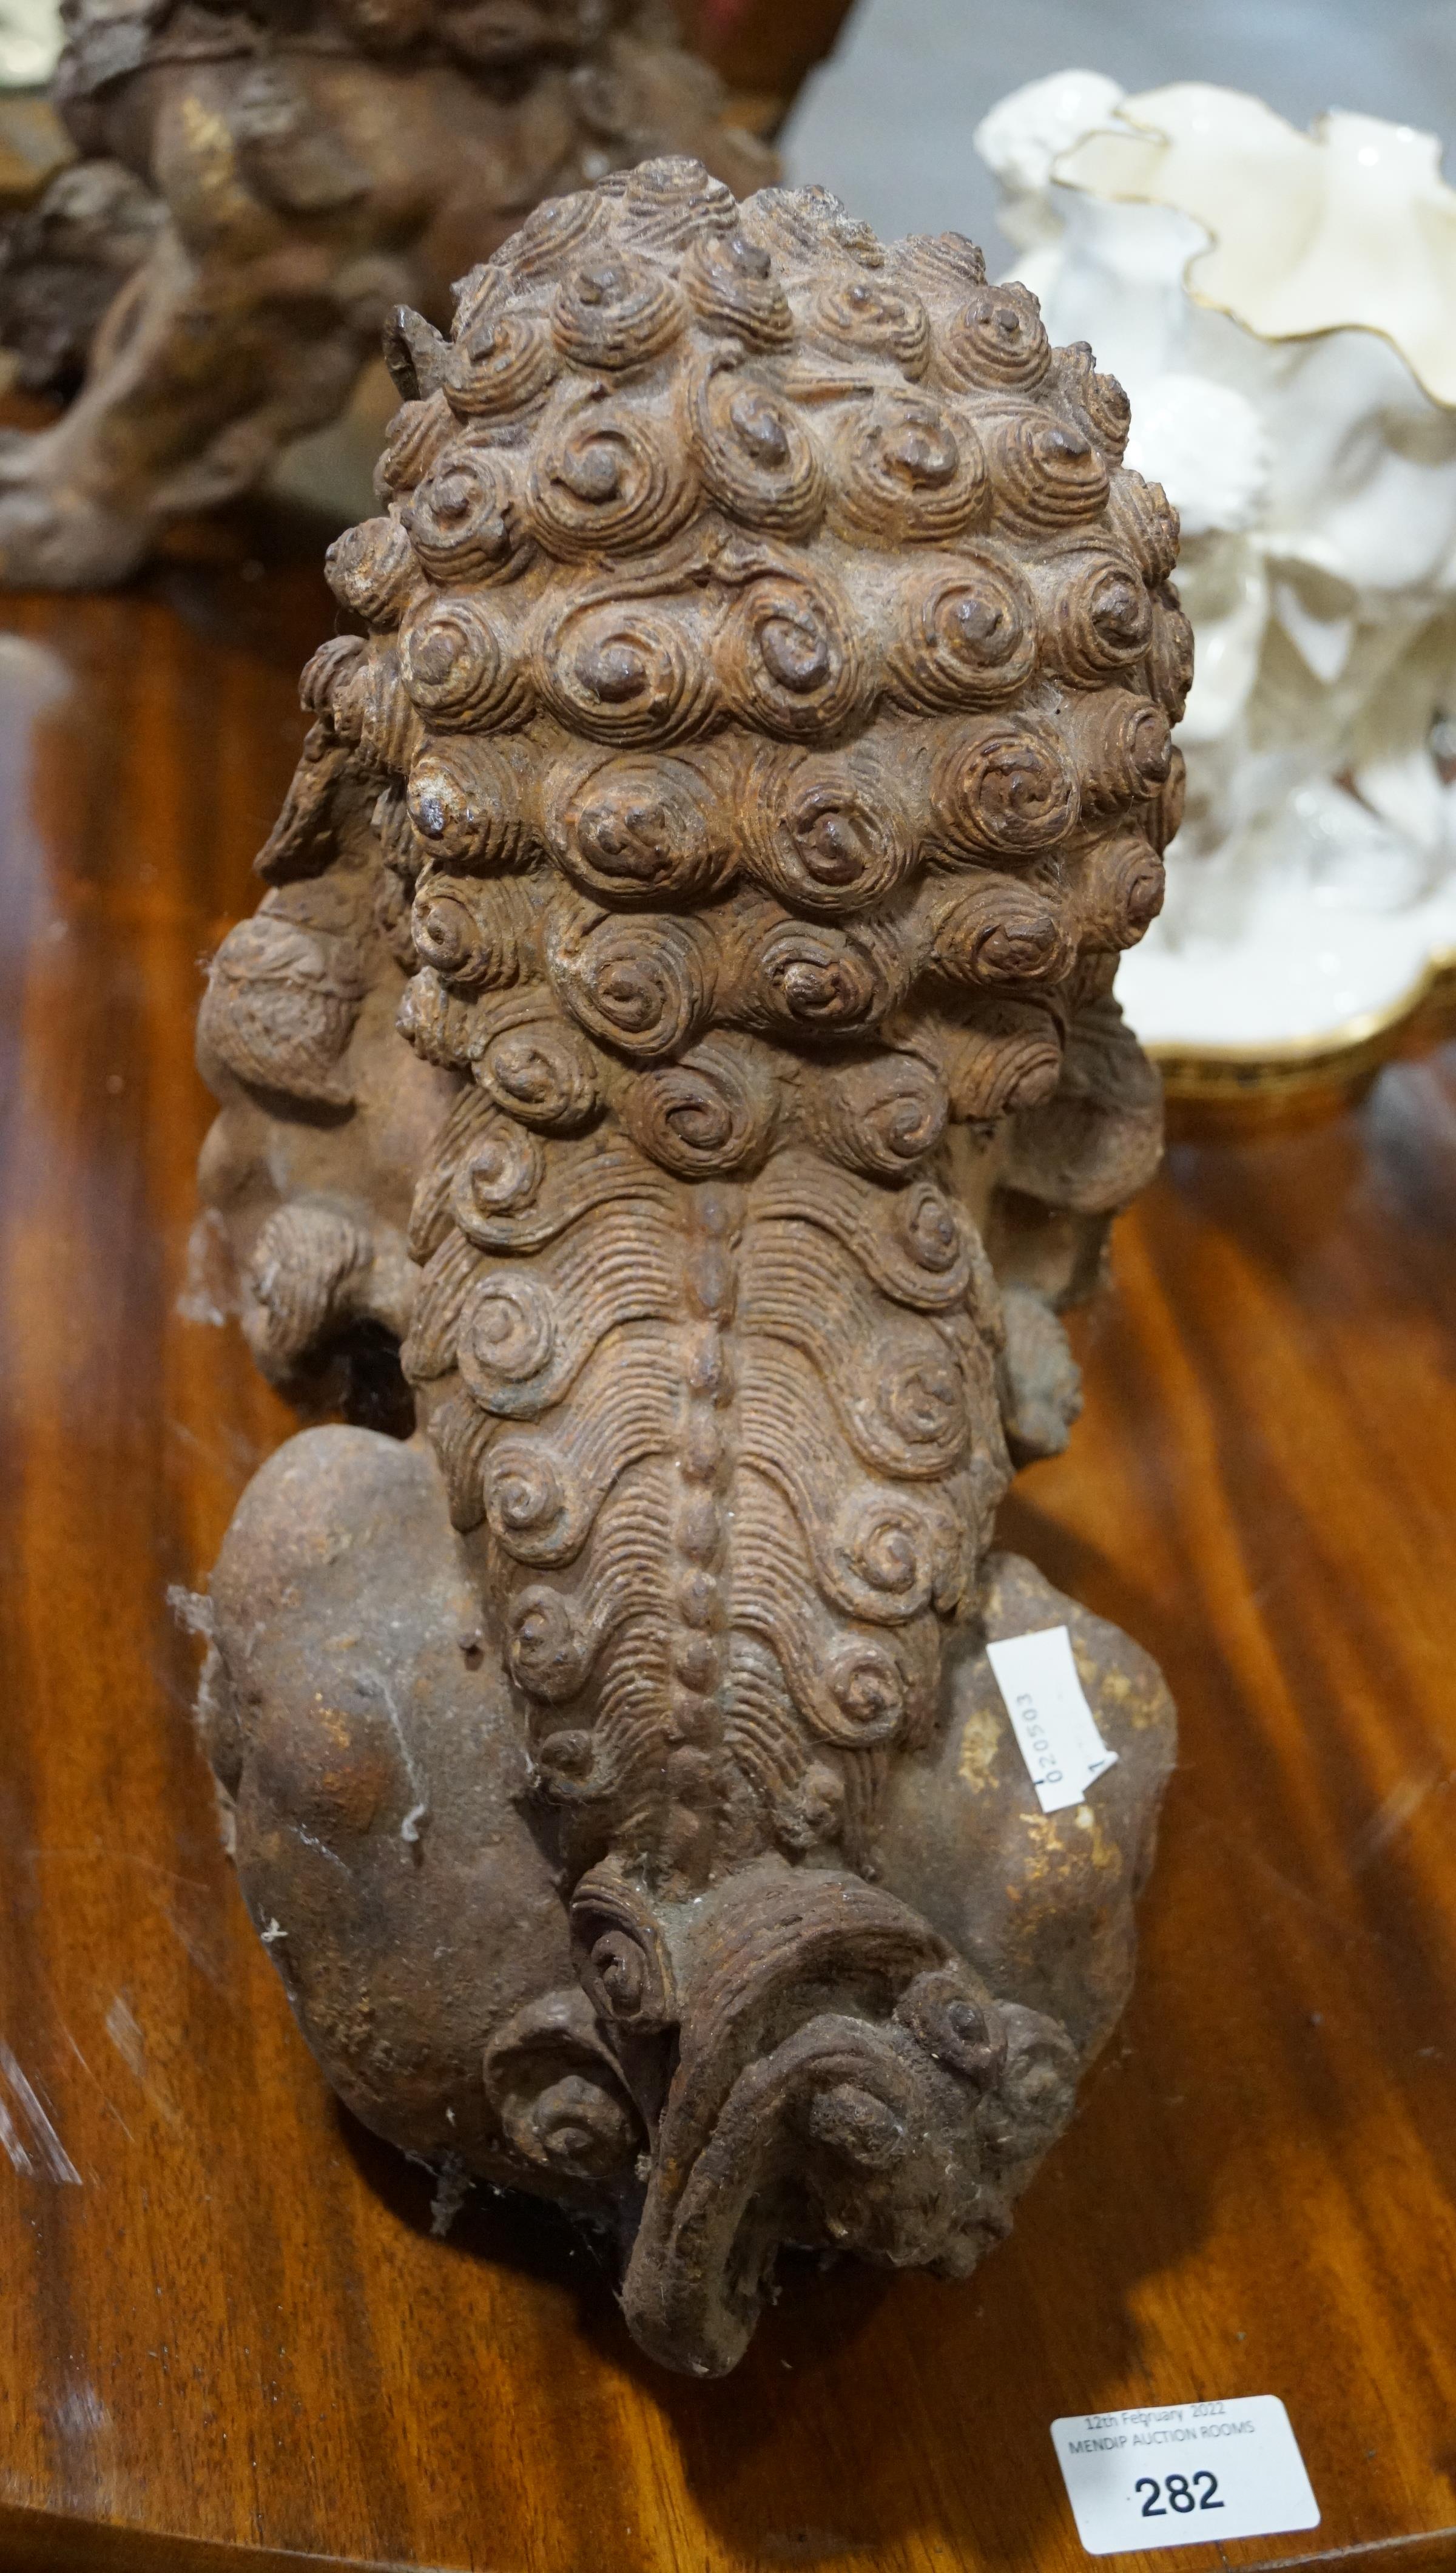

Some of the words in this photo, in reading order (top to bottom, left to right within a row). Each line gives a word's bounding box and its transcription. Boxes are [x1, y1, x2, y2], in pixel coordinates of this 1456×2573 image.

[1084, 2412, 1119, 2430] 12th
[1190, 2401, 1226, 2418] 2022
[1068, 2435, 1128, 2454] MENDIP
[1133, 2425, 1198, 2447] AUCTION
[1201, 2420, 1255, 2438] ROOMS
[1134, 2470, 1225, 2517] 282
